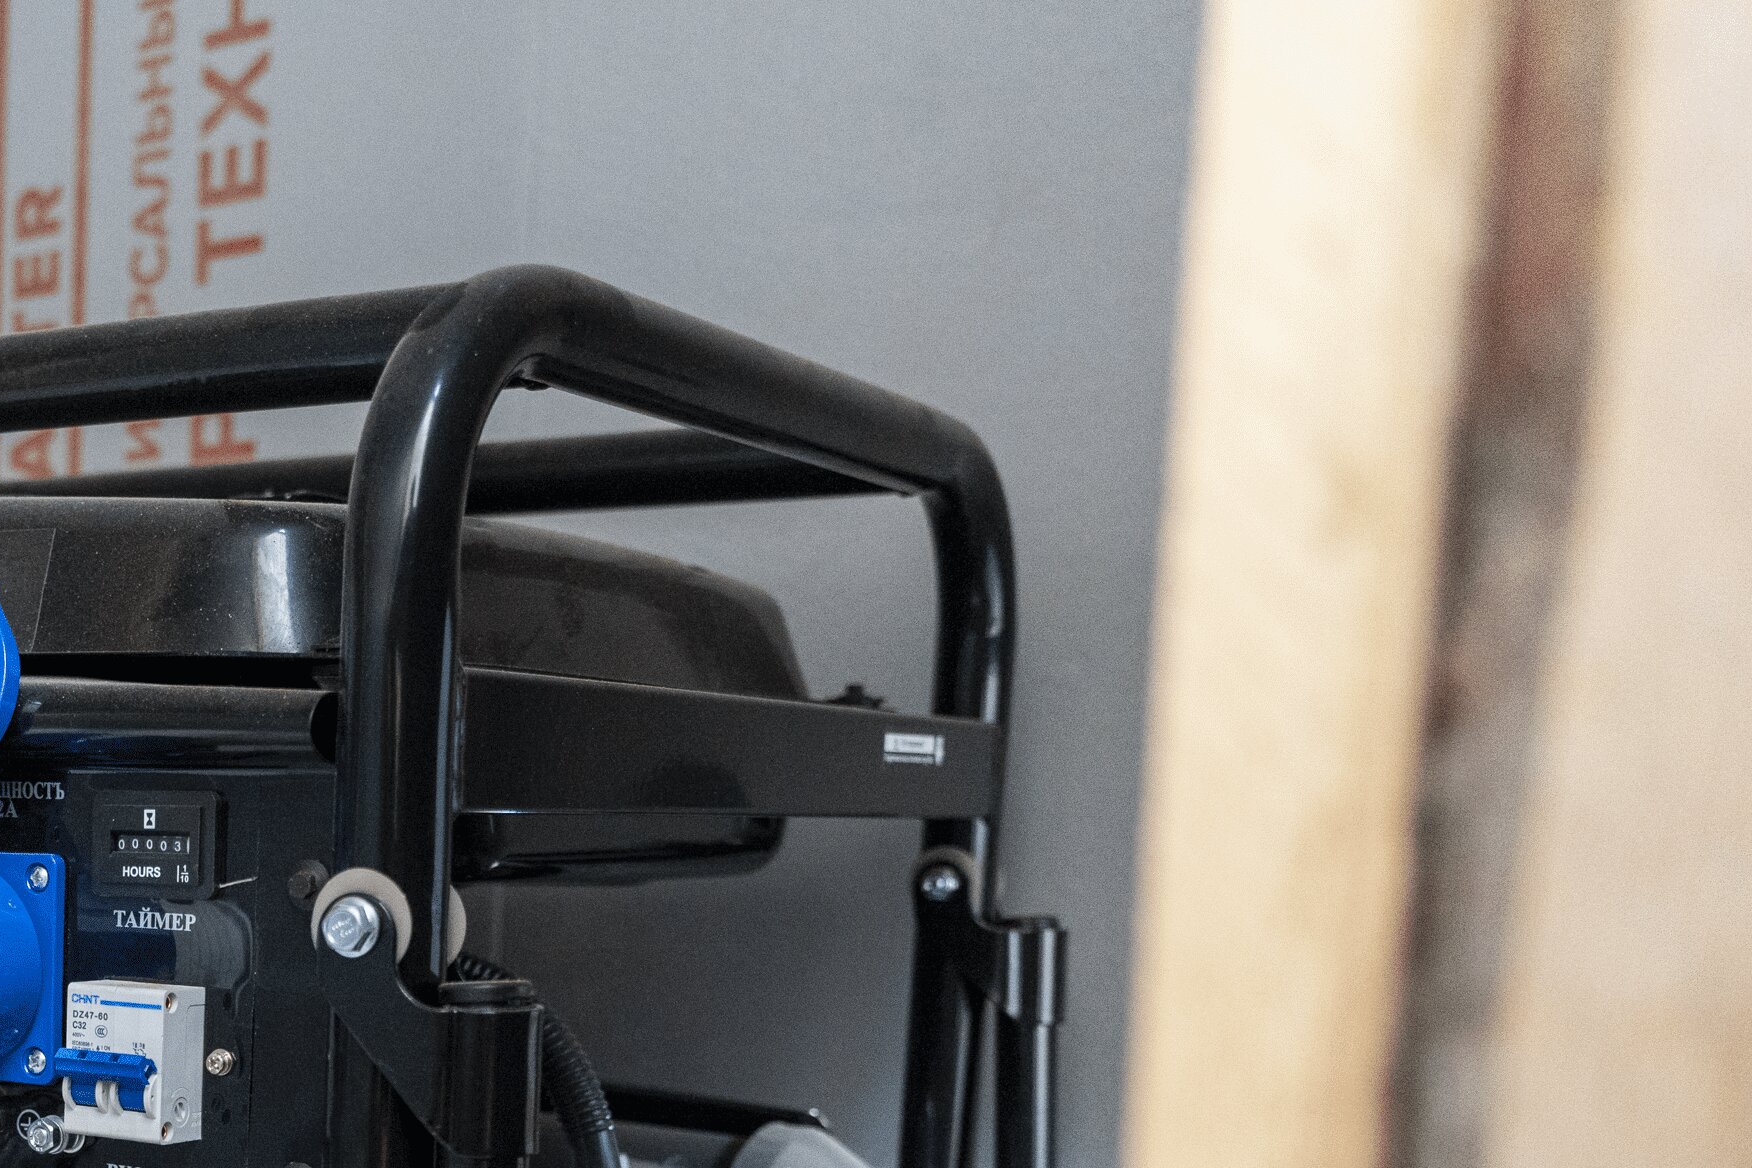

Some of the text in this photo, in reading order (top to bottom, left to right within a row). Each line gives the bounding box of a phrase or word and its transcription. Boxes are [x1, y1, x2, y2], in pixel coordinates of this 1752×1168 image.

[122, 866, 161, 878] HOURS
[113, 907, 196, 932] ТАЙМЕР
[71, 993, 100, 1004] CHNT
[72, 1010, 108, 1021] DZ47-60
[72, 1021, 87, 1030] C32
